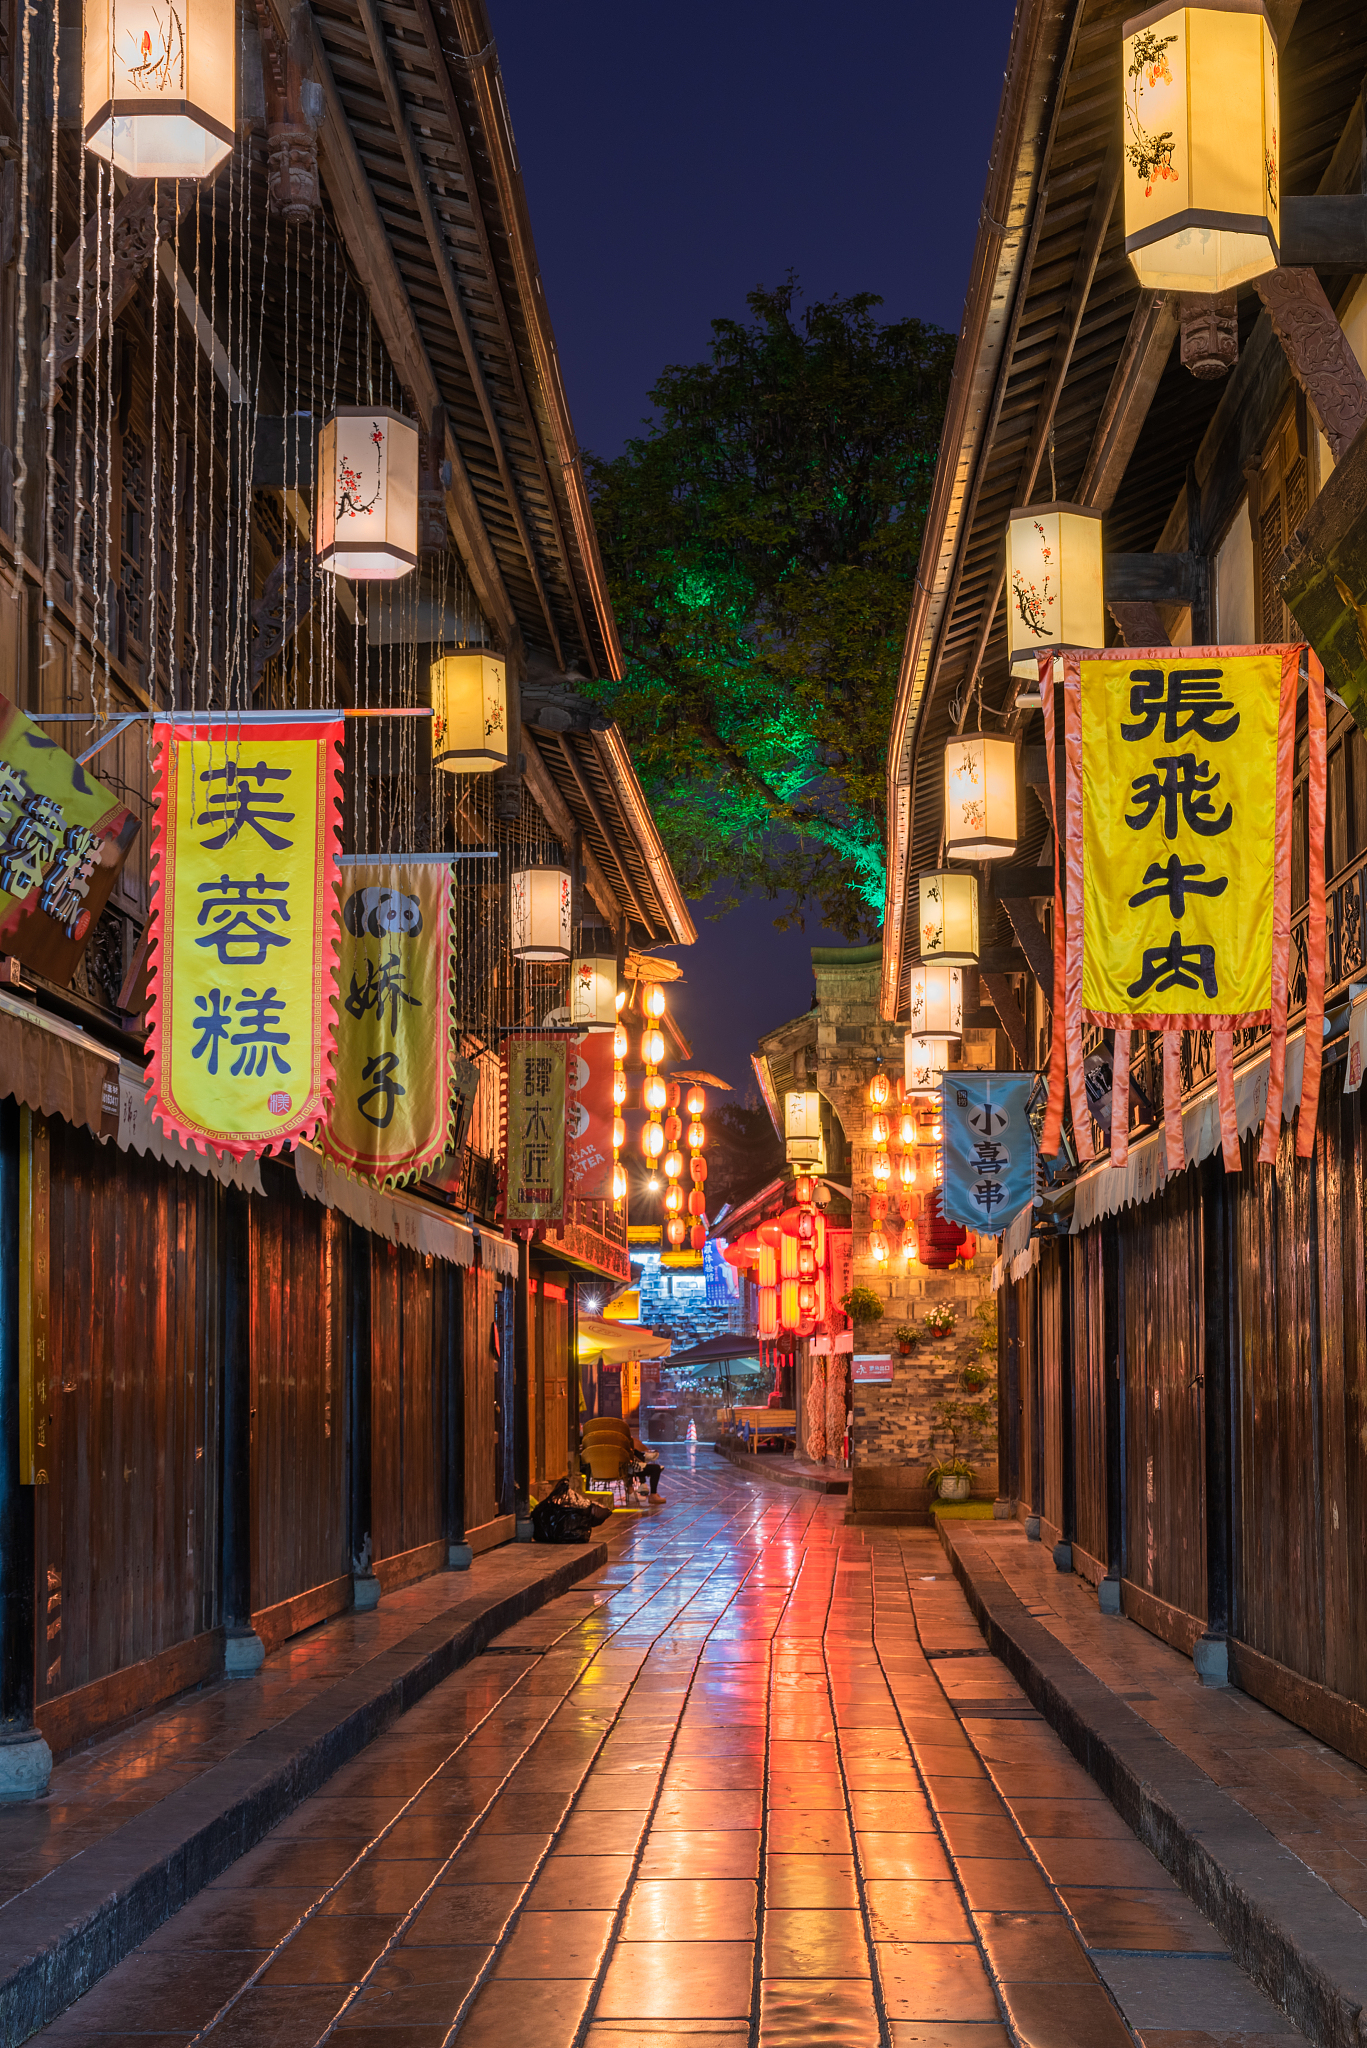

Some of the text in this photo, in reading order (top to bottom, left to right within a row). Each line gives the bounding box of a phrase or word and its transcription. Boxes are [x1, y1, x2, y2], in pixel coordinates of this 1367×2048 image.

[192, 761, 294, 1077] 芙蓉糕
[1121, 669, 1239, 999] 張飛牛肉
[578, 1154, 606, 1173] TEA
[969, 1103, 1009, 1214] 小喜串
